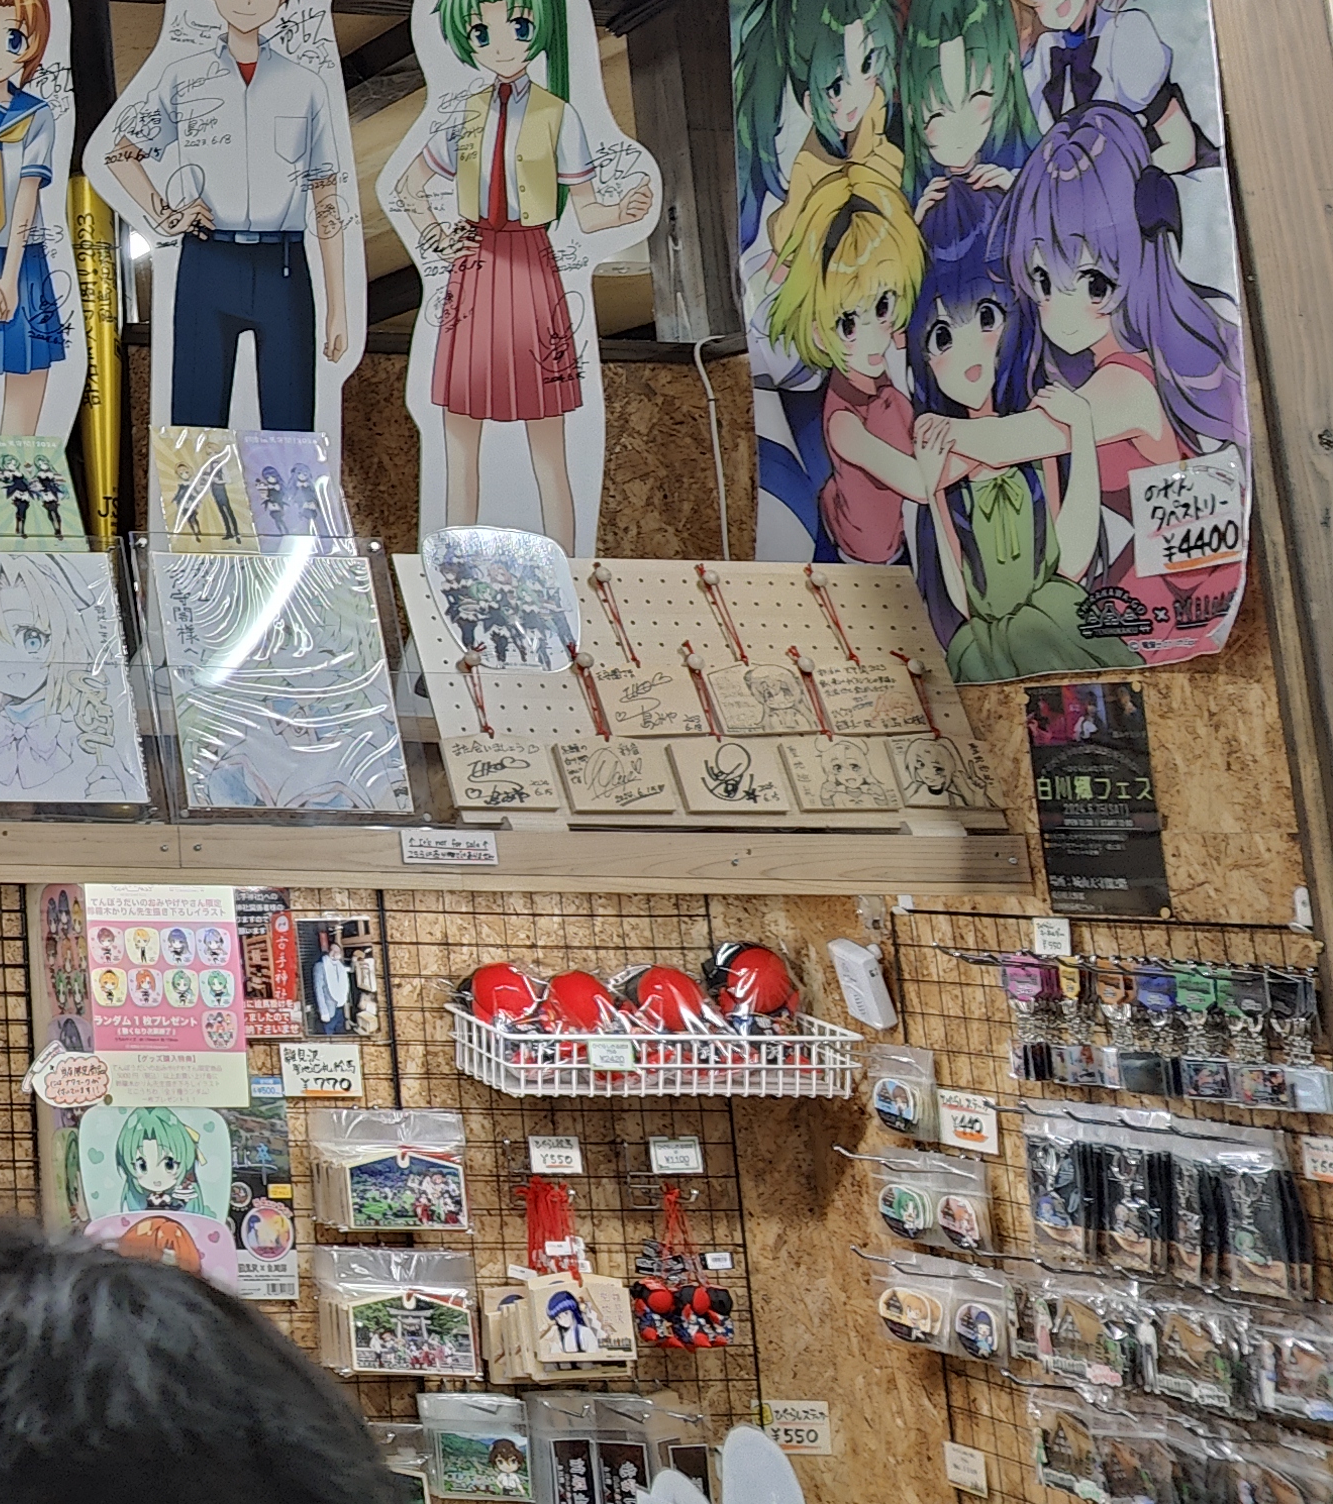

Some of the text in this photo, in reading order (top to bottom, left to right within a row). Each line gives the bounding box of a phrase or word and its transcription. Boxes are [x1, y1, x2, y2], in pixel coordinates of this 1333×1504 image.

[1150, 494, 1229, 532] タペストリー
[1161, 519, 1239, 564] ¥4400
[1036, 777, 1154, 802] 白川郷フェス
[299, 1076, 353, 1092] ¥770
[539, 1152, 574, 1166] ¥550
[771, 1427, 820, 1445] ¥550
